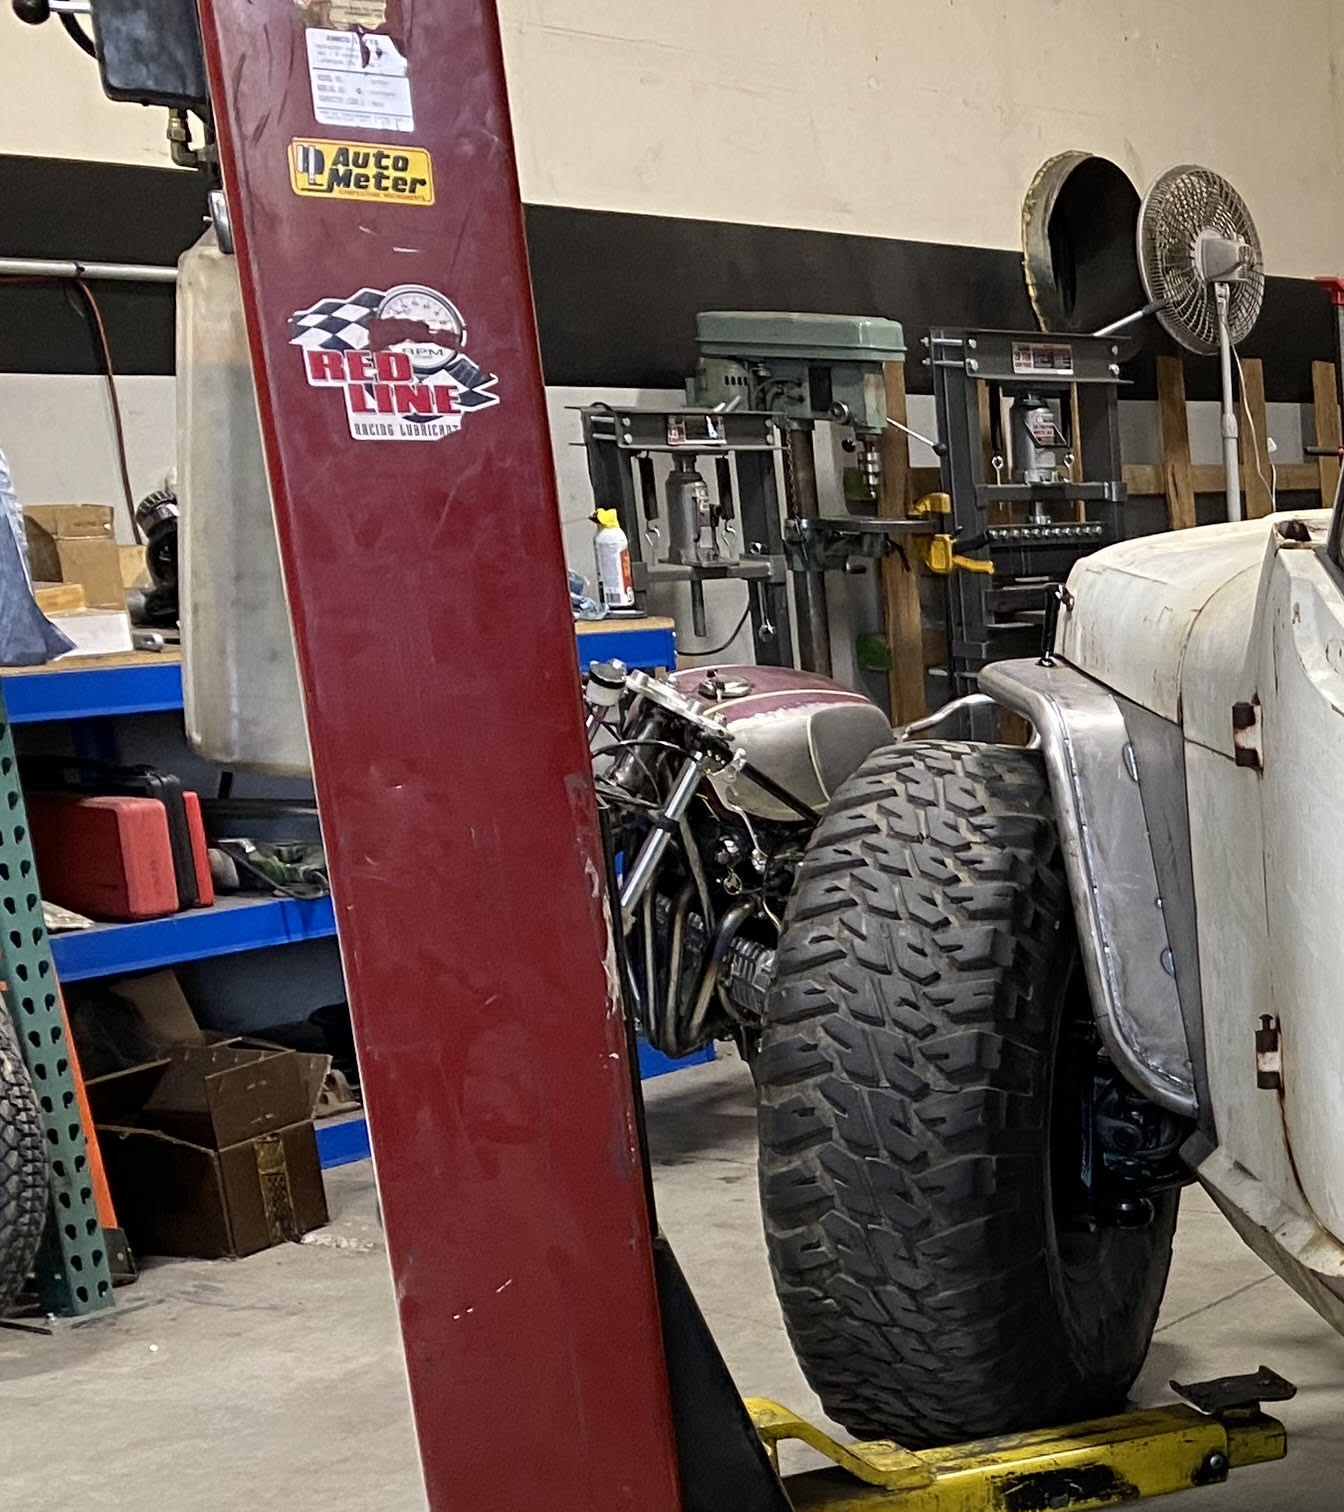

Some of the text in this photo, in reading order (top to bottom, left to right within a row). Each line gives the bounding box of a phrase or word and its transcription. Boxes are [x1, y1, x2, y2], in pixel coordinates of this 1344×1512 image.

[331, 147, 409, 172] Auto
[327, 168, 427, 193] Meter
[306, 350, 413, 381] RED
[348, 383, 461, 414] LINE
[354, 423, 394, 436] RACING
